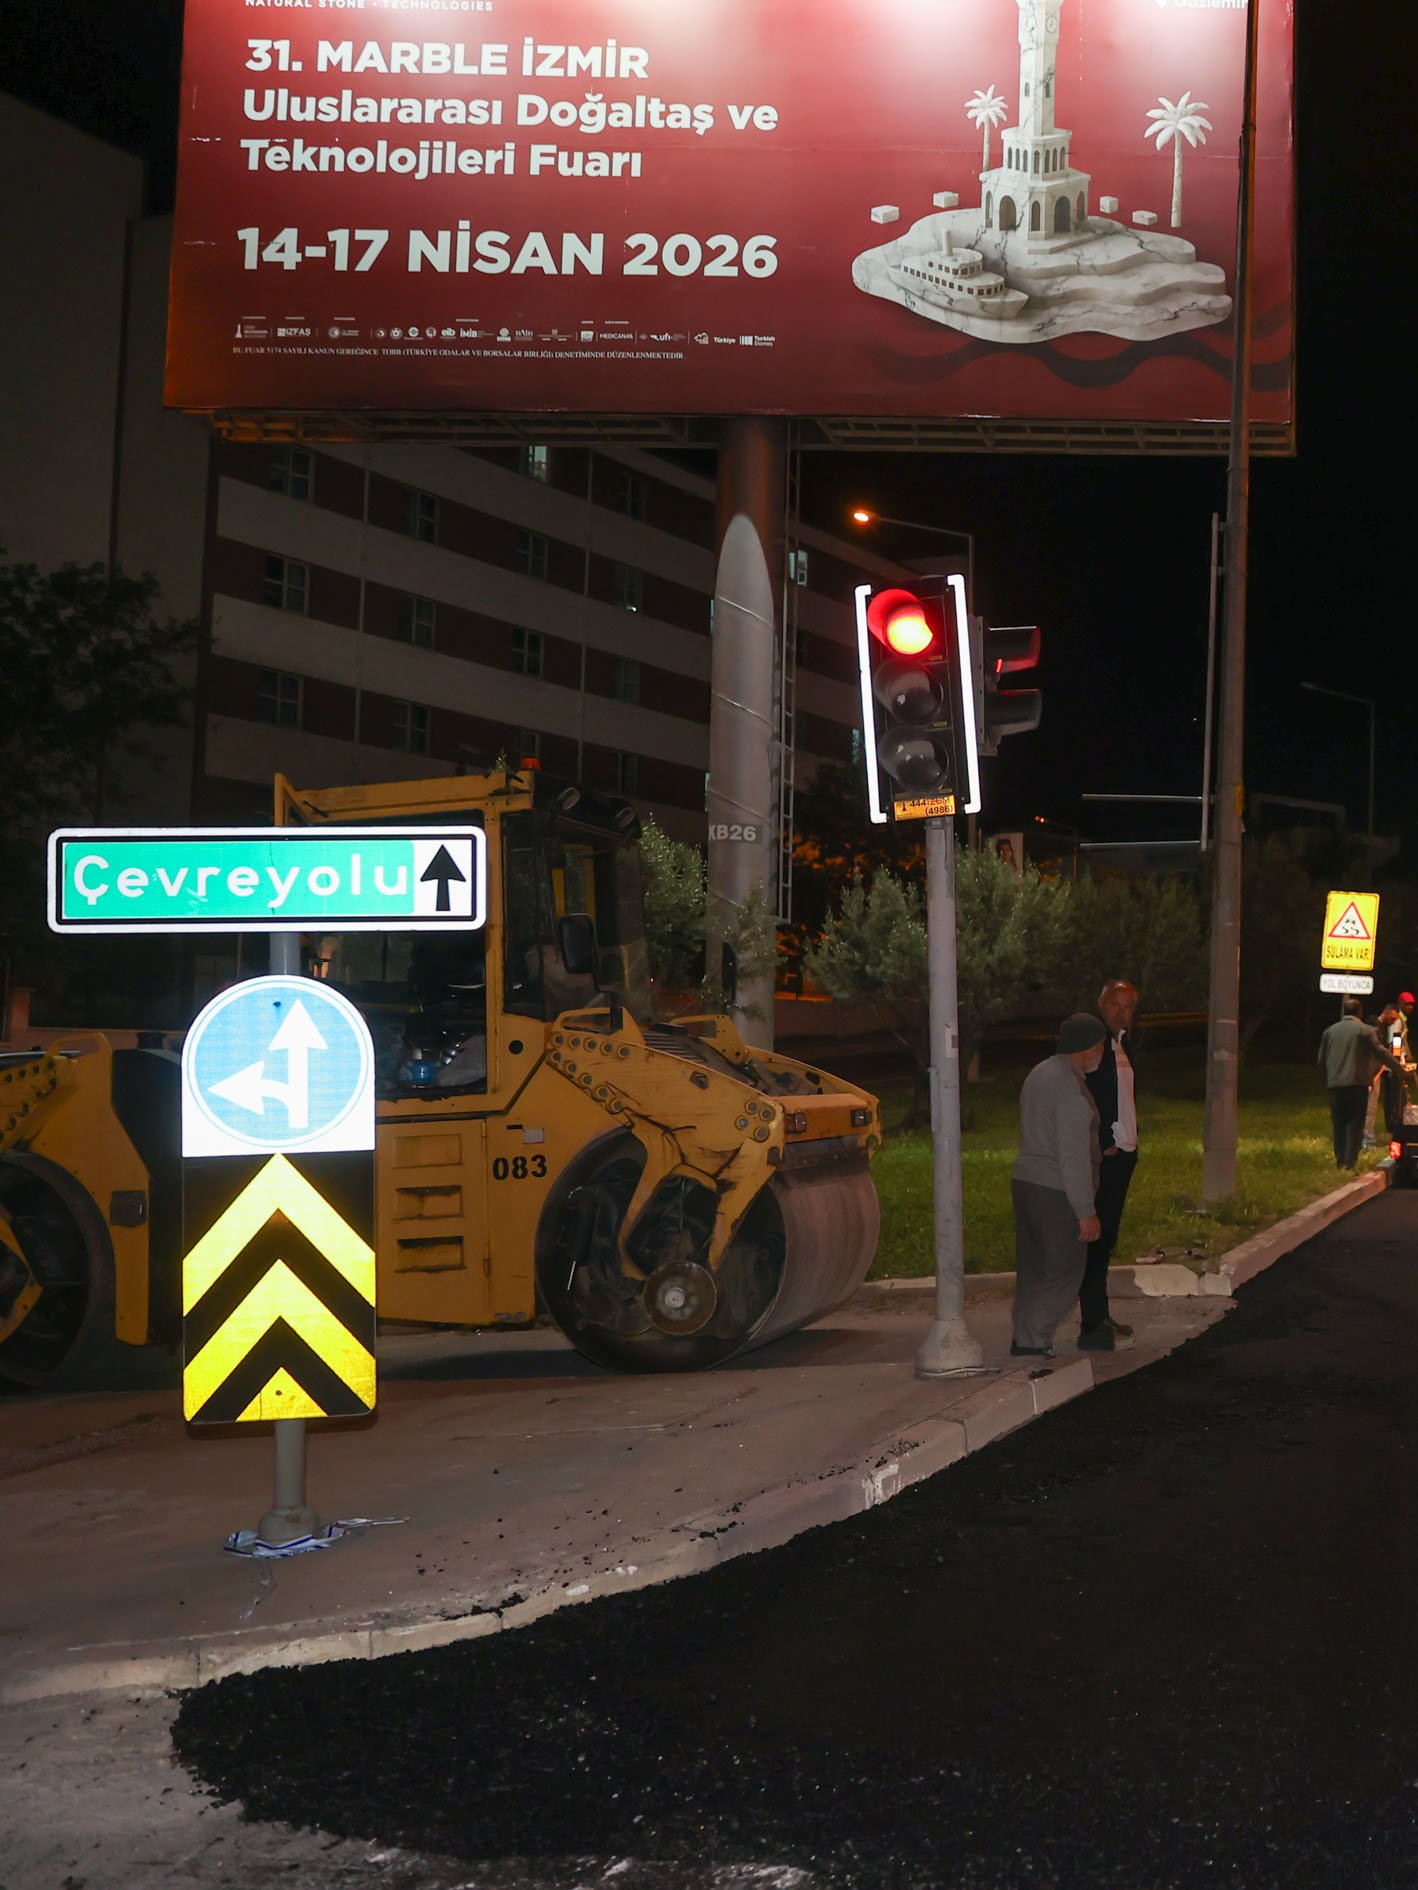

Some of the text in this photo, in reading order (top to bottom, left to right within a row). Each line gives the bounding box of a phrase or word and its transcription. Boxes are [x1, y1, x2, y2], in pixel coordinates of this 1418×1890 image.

[245, 0, 493, 11] NATURAL STONE TECHNOLOGIES
[244, 36, 650, 79] 31. MARBLE İZMİR
[243, 88, 779, 135] Uluslararası Doğaltaş ve
[241, 138, 642, 180] Teknolojileri Fuarı
[237, 220, 778, 279] 14-17 NİSAN 2026
[308, 347, 335, 355] KANUN
[439, 348, 470, 357] ODALAR
[471, 349, 482, 357] VE
[483, 349, 522, 358] BORSALAR
[925, 804, 953, 817] (4986)
[73, 852, 410, 908] Çevreyolu
[493, 1153, 548, 1182] 083
